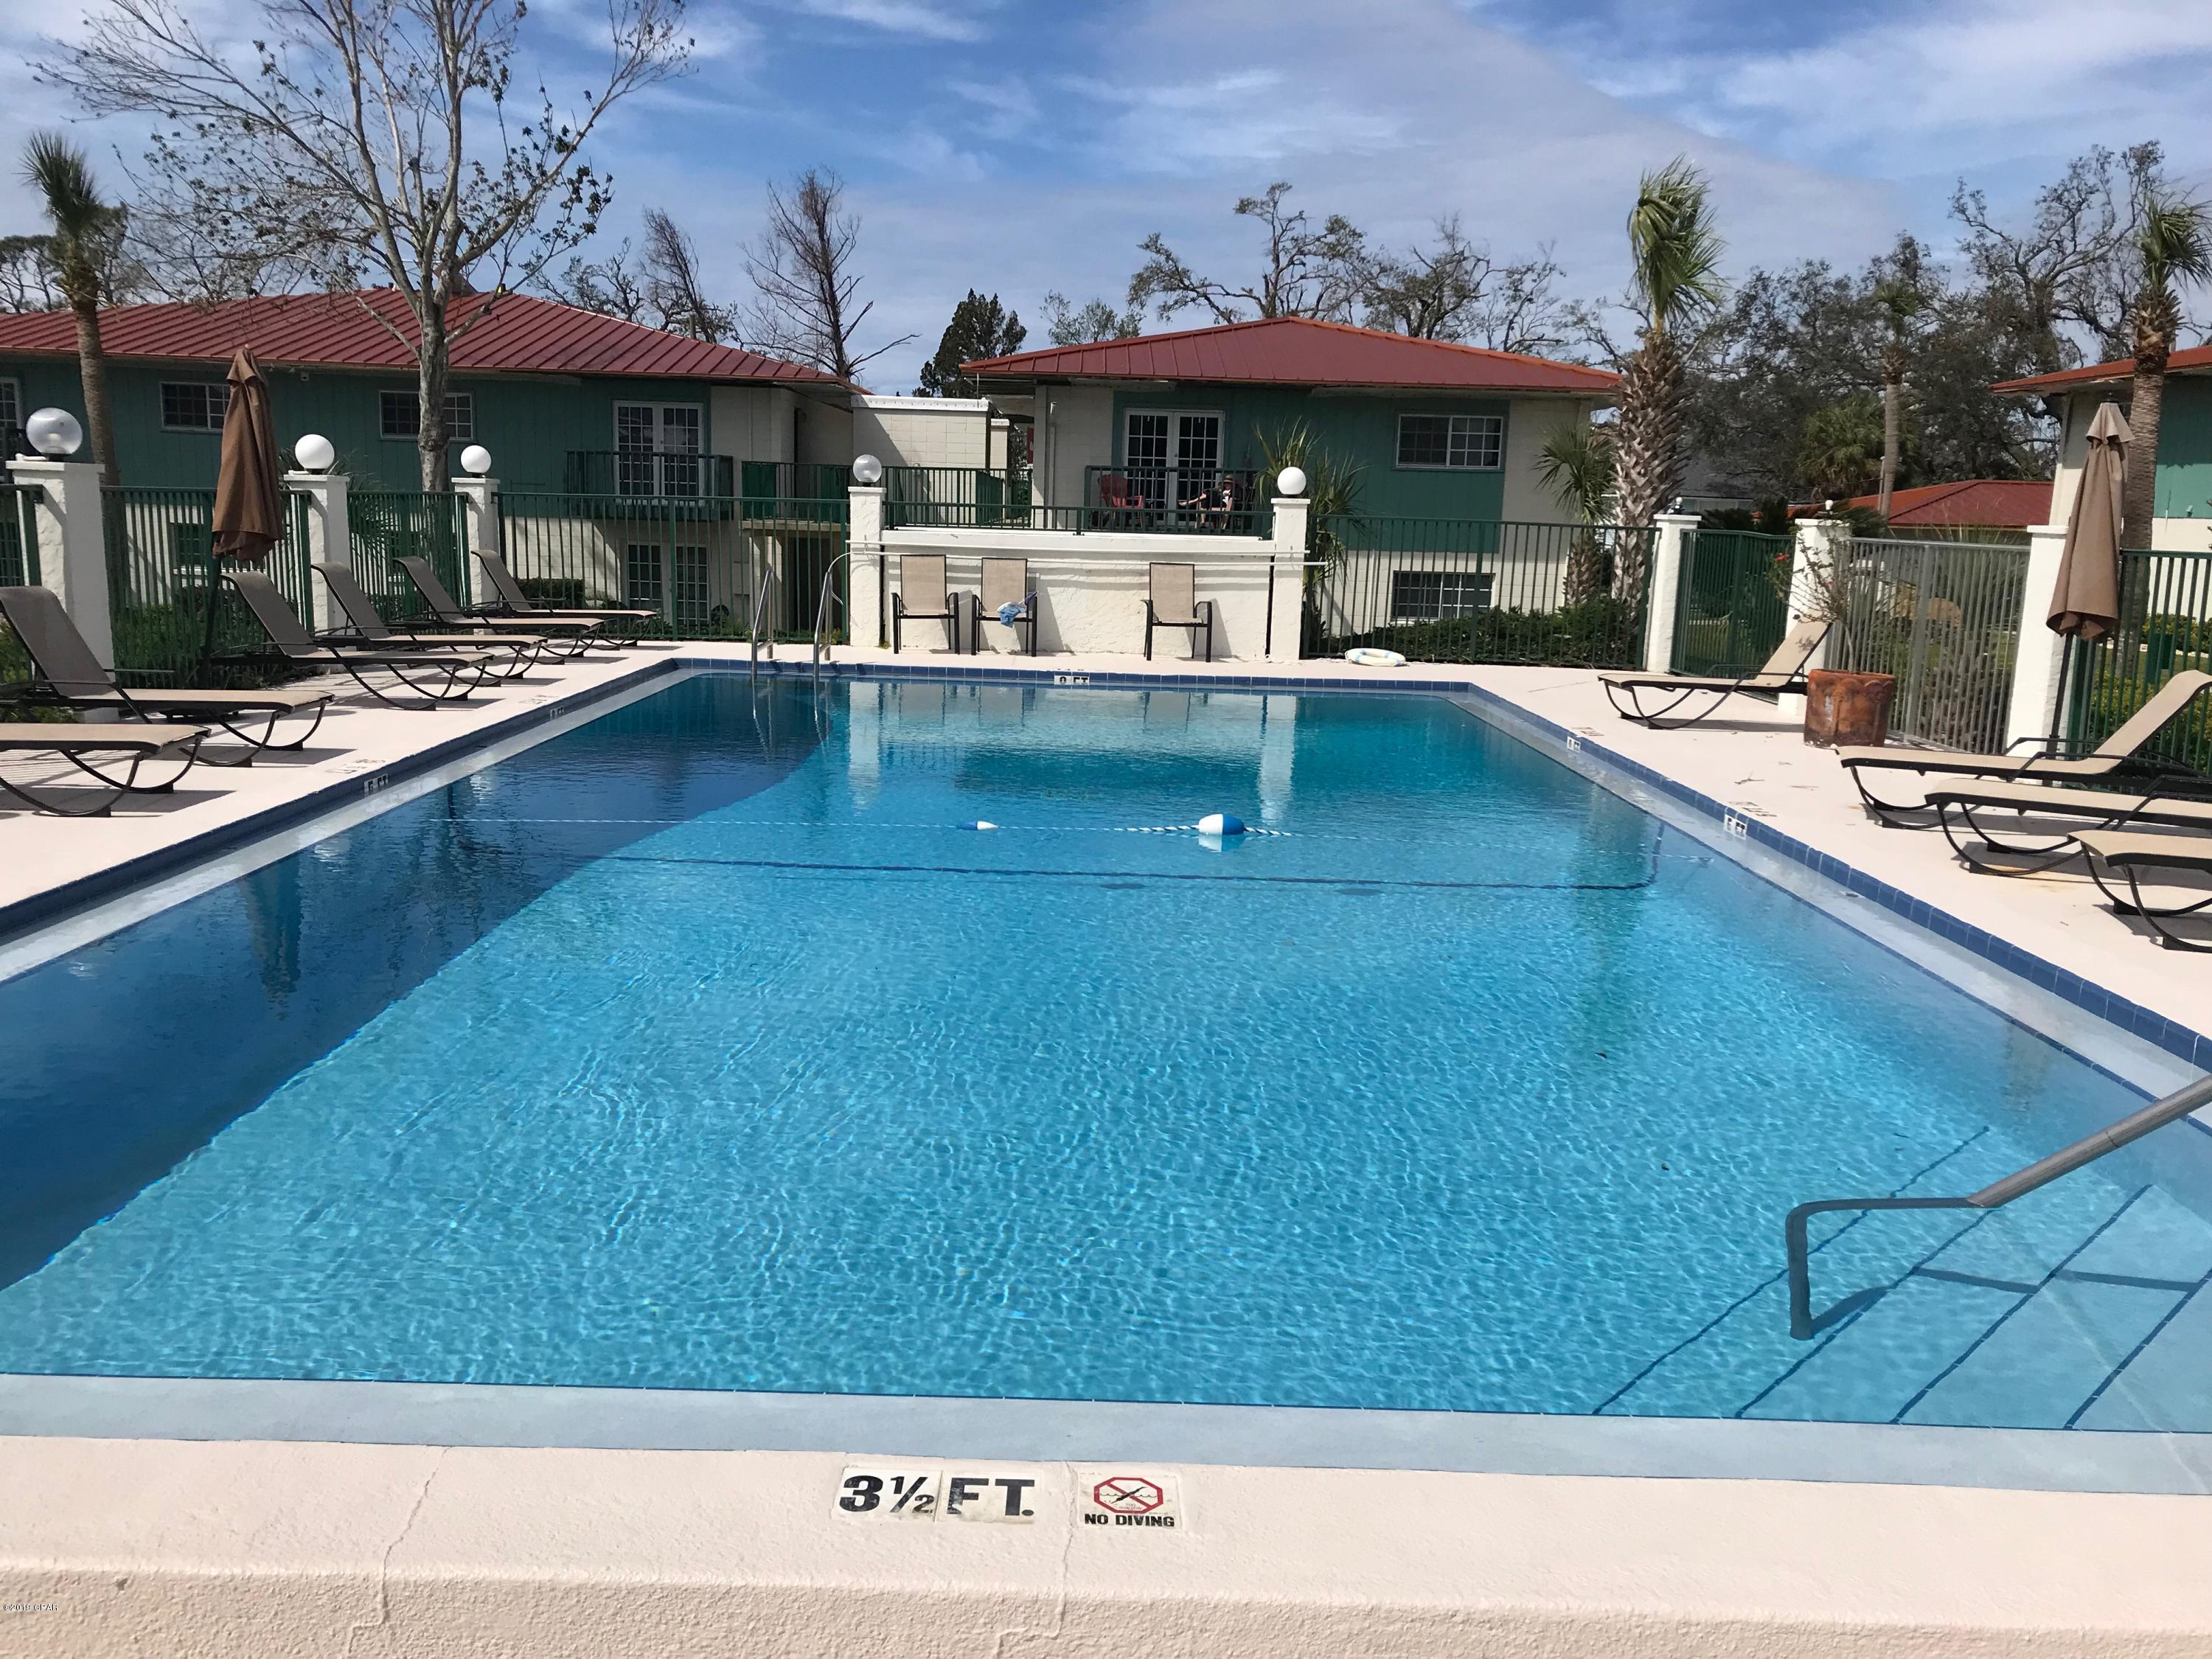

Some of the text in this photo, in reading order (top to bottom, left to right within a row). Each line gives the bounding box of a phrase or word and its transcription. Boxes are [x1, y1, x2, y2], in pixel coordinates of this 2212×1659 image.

[947, 1477, 1035, 1516] FT.
[1085, 1513, 1175, 1528] NO DIVING
